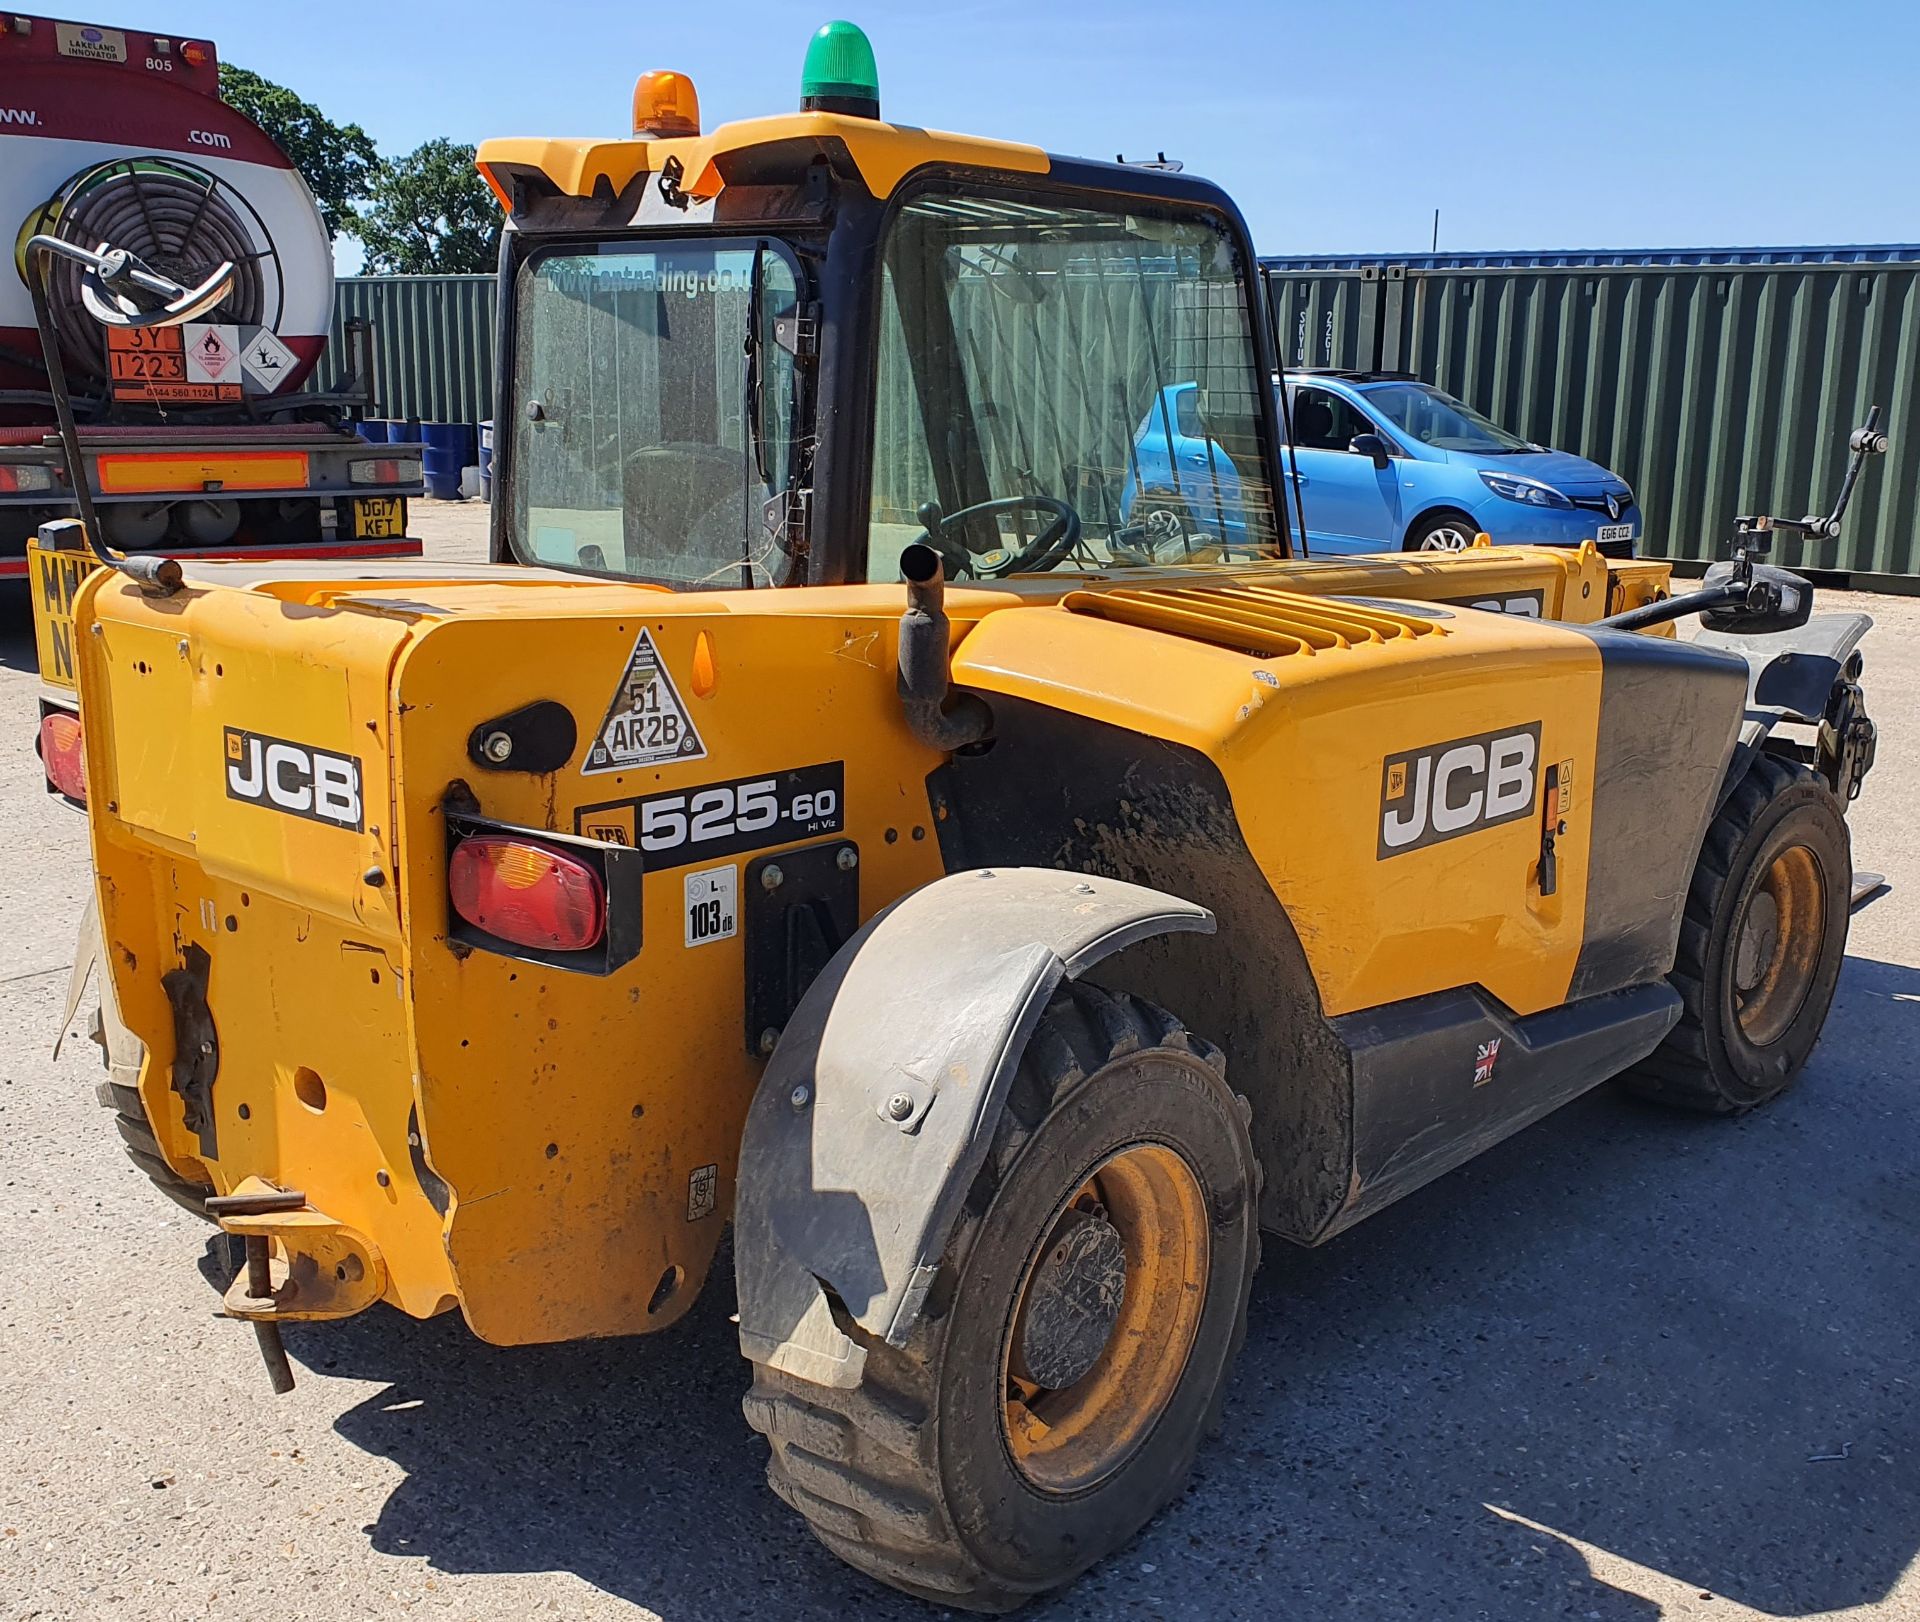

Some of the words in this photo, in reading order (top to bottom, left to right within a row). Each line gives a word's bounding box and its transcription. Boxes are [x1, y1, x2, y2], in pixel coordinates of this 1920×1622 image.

[69, 48, 118, 60] INNOVATOR
[70, 40, 116, 52] LAKELAND
[146, 58, 173, 72] 805
[188, 130, 231, 148] .com
[130, 327, 161, 348] 3Y
[1297, 311, 1306, 361] SKYU
[1325, 311, 1333, 361] 22G1
[117, 355, 181, 377] 1223
[192, 388, 214, 398] 1124
[362, 500, 396, 517] DG17
[629, 681, 661, 715] 51
[611, 714, 679, 752] AR2B
[229, 738, 361, 823] JCB
[1383, 733, 1536, 847] JCB
[808, 822, 819, 832] Hi
[821, 819, 836, 828] Viz
[690, 900, 720, 940] 103
[722, 915, 733, 932] dB
